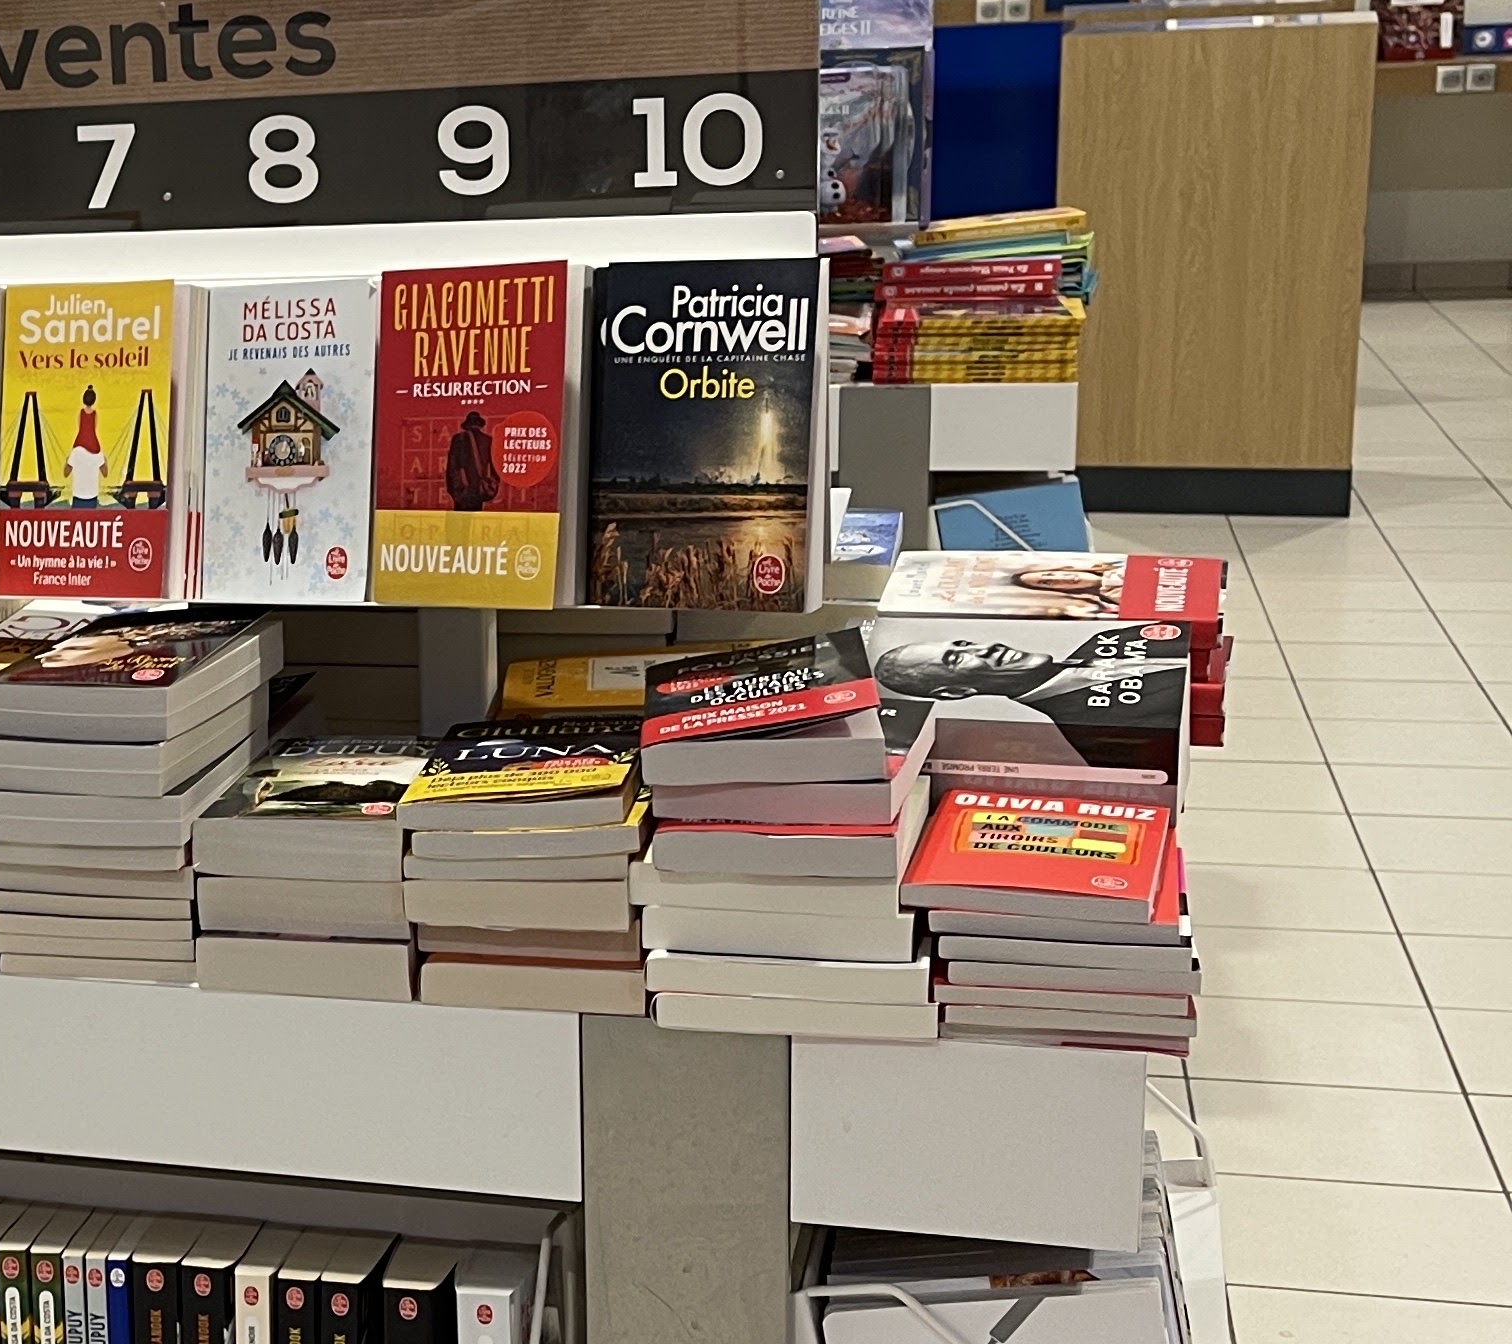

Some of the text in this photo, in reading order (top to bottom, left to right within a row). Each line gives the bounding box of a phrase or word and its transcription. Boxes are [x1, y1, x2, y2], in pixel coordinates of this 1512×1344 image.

[77, 123, 136, 208] 7
[247, 116, 319, 204] 8
[437, 105, 510, 196] 9
[632, 92, 763, 189] 10
[45, 293, 107, 318] Julien
[242, 296, 337, 321] MÉLISSA
[394, 275, 555, 331] GIACOMETTI
[672, 283, 784, 319] Patricia
[19, 305, 161, 345] Sandrel
[242, 319, 336, 343] DA COSTA
[611, 297, 809, 354] Cornwell
[19, 345, 150, 370] Vers le soleil
[228, 343, 351, 362] JE REVENAIS DES AUTRES
[414, 325, 532, 378] RAVENNE
[614, 353, 806, 364] UNE ENQUÊTE DE LA CAPITAINE CHASE
[412, 375, 531, 399] RÉSURRECTION
[660, 367, 755, 399] Orbite
[504, 437, 552, 451] LECTEURS
[505, 426, 547, 439] PRIX DES
[502, 462, 527, 474] 2022
[5, 515, 124, 548] NOUVEAUTÉ
[17, 554, 104, 571] Un hymne à la vie
[380, 541, 508, 575] NOUVEAUTÉ
[33, 571, 92, 586] France Inter
[1153, 566, 1189, 613] NOUVEAUTÉ
[703, 668, 810, 695] LE BUREAU
[1088, 634, 1120, 707] BARACK
[1117, 639, 1148, 704] OBAMA
[691, 670, 824, 704] DES AFFAIRES
[710, 682, 806, 706] OCCULTES
[660, 702, 807, 735] DE LA PRESSE 2021
[682, 700, 783, 723] PRIX MAISON
[454, 744, 616, 761] LUNA
[954, 793, 1157, 821] OLIVIA RUIZ
[981, 822, 1022, 833] AUX
[986, 814, 1120, 831] LA COMMODE
[973, 841, 1117, 860] DE COULEURS
[978, 832, 1059, 844] TIROIRS
